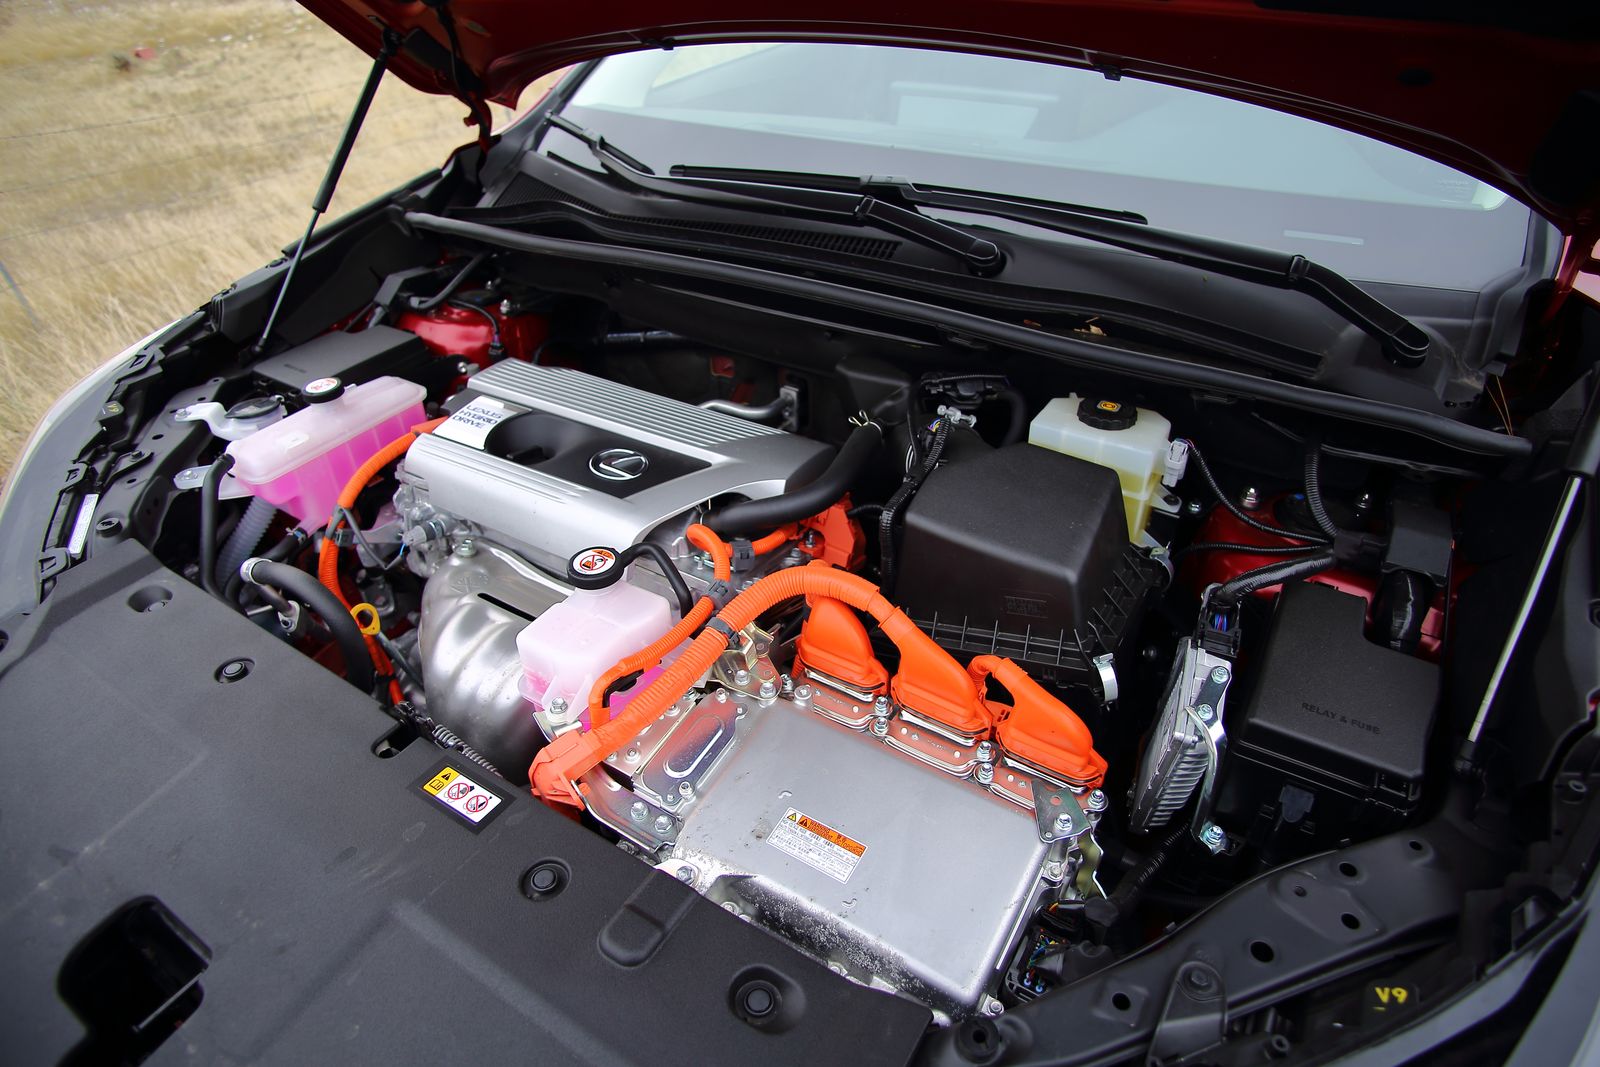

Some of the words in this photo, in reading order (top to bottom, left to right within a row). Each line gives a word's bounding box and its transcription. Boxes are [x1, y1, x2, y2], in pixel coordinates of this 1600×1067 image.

[458, 409, 498, 425] HYBRID
[466, 405, 503, 419] LEXUS
[452, 415, 486, 429] DRIVE
[1301, 702, 1337, 719] RELAY
[1351, 719, 1381, 735] FUSE
[1375, 987, 1407, 1004] V9
